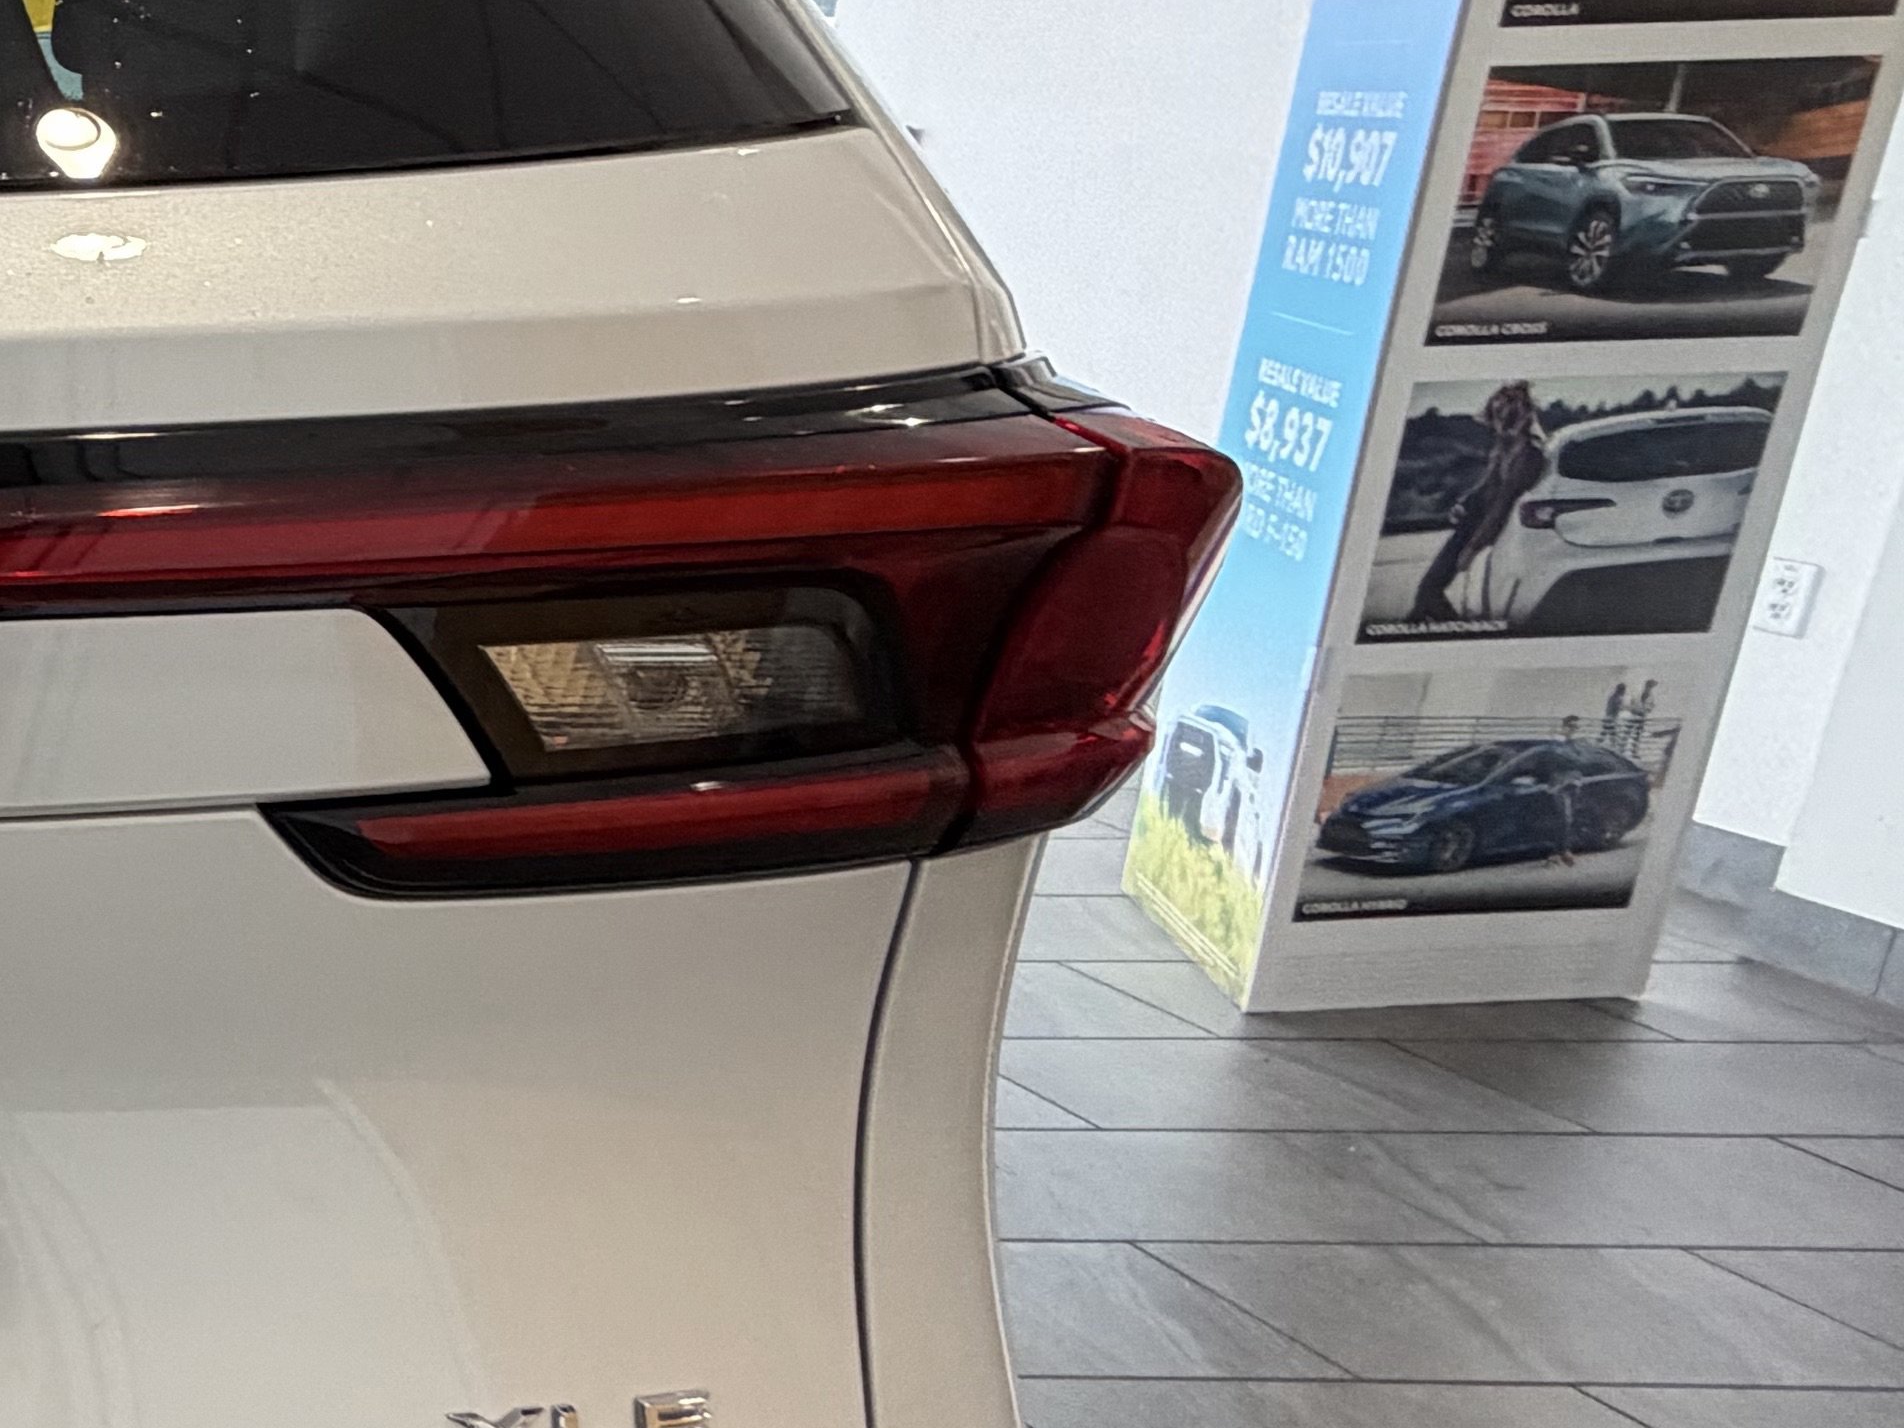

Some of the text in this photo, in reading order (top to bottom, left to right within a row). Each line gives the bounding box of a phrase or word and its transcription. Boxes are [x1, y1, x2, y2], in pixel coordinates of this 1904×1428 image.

[1511, 2, 1580, 18] COROLLA
[1302, 122, 1398, 193] $10,907
[1245, 389, 1333, 473] $8,937
